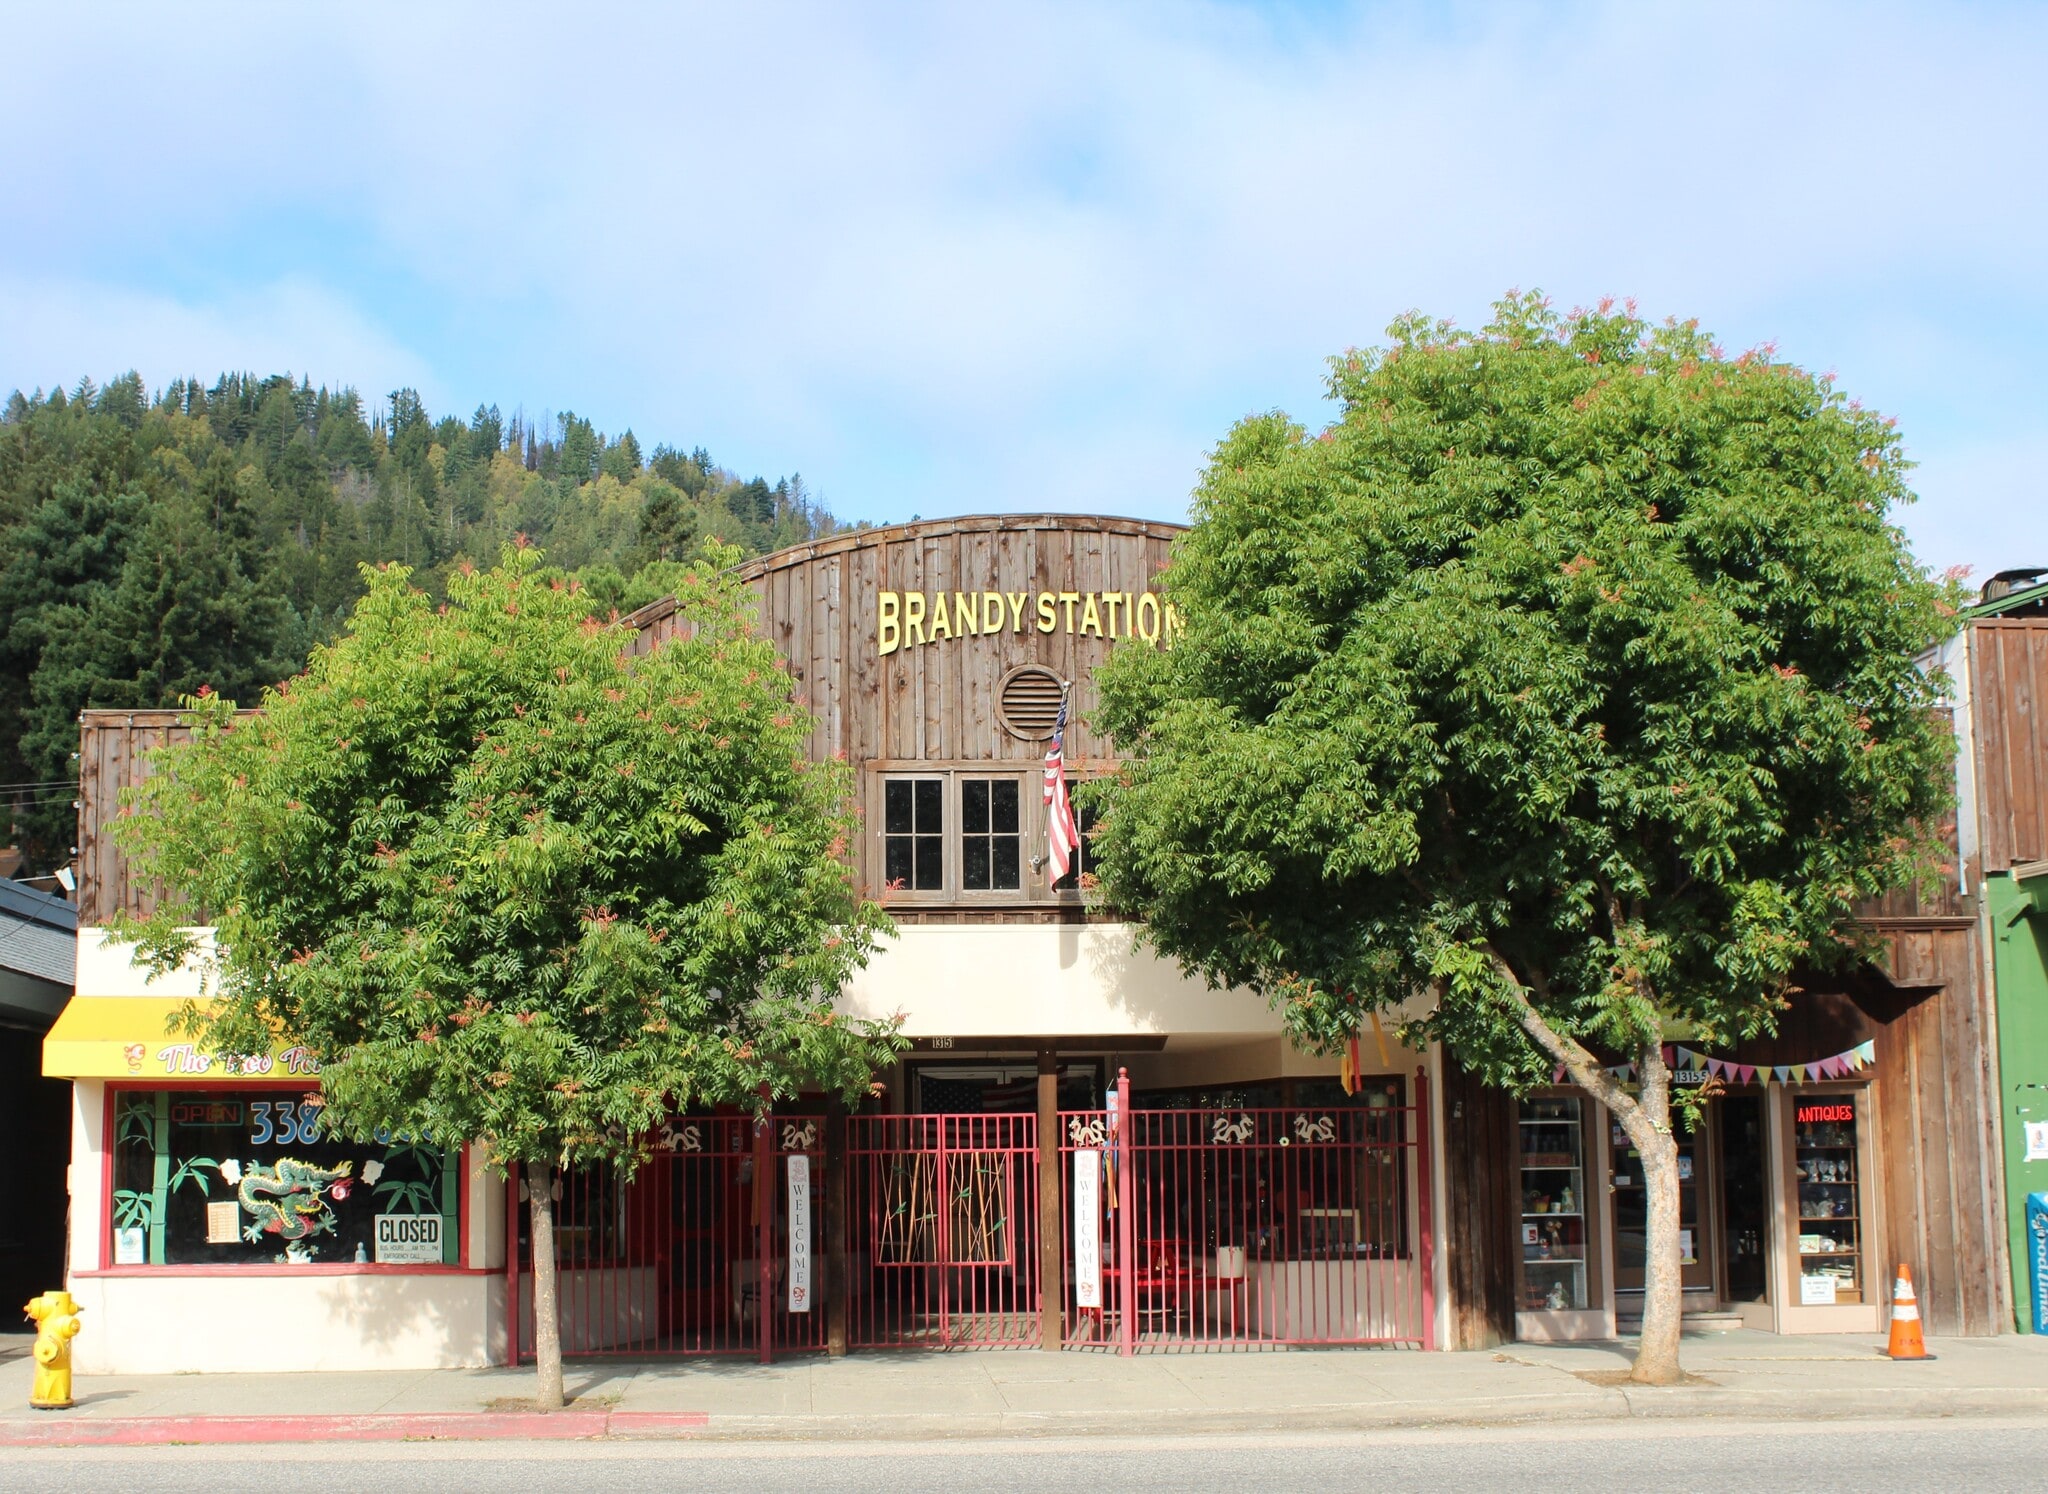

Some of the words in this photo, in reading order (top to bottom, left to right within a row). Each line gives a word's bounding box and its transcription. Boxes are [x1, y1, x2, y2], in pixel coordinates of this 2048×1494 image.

[878, 591, 1028, 656] BRANDY
[156, 1043, 211, 1074] The
[171, 1104, 237, 1122] OPEN
[1797, 1105, 1853, 1122] ANTIQUES
[380, 1219, 439, 1243] CLOSED
[793, 1184, 805, 1284] WELCOME
[1080, 1180, 1092, 1279] WELCOME
